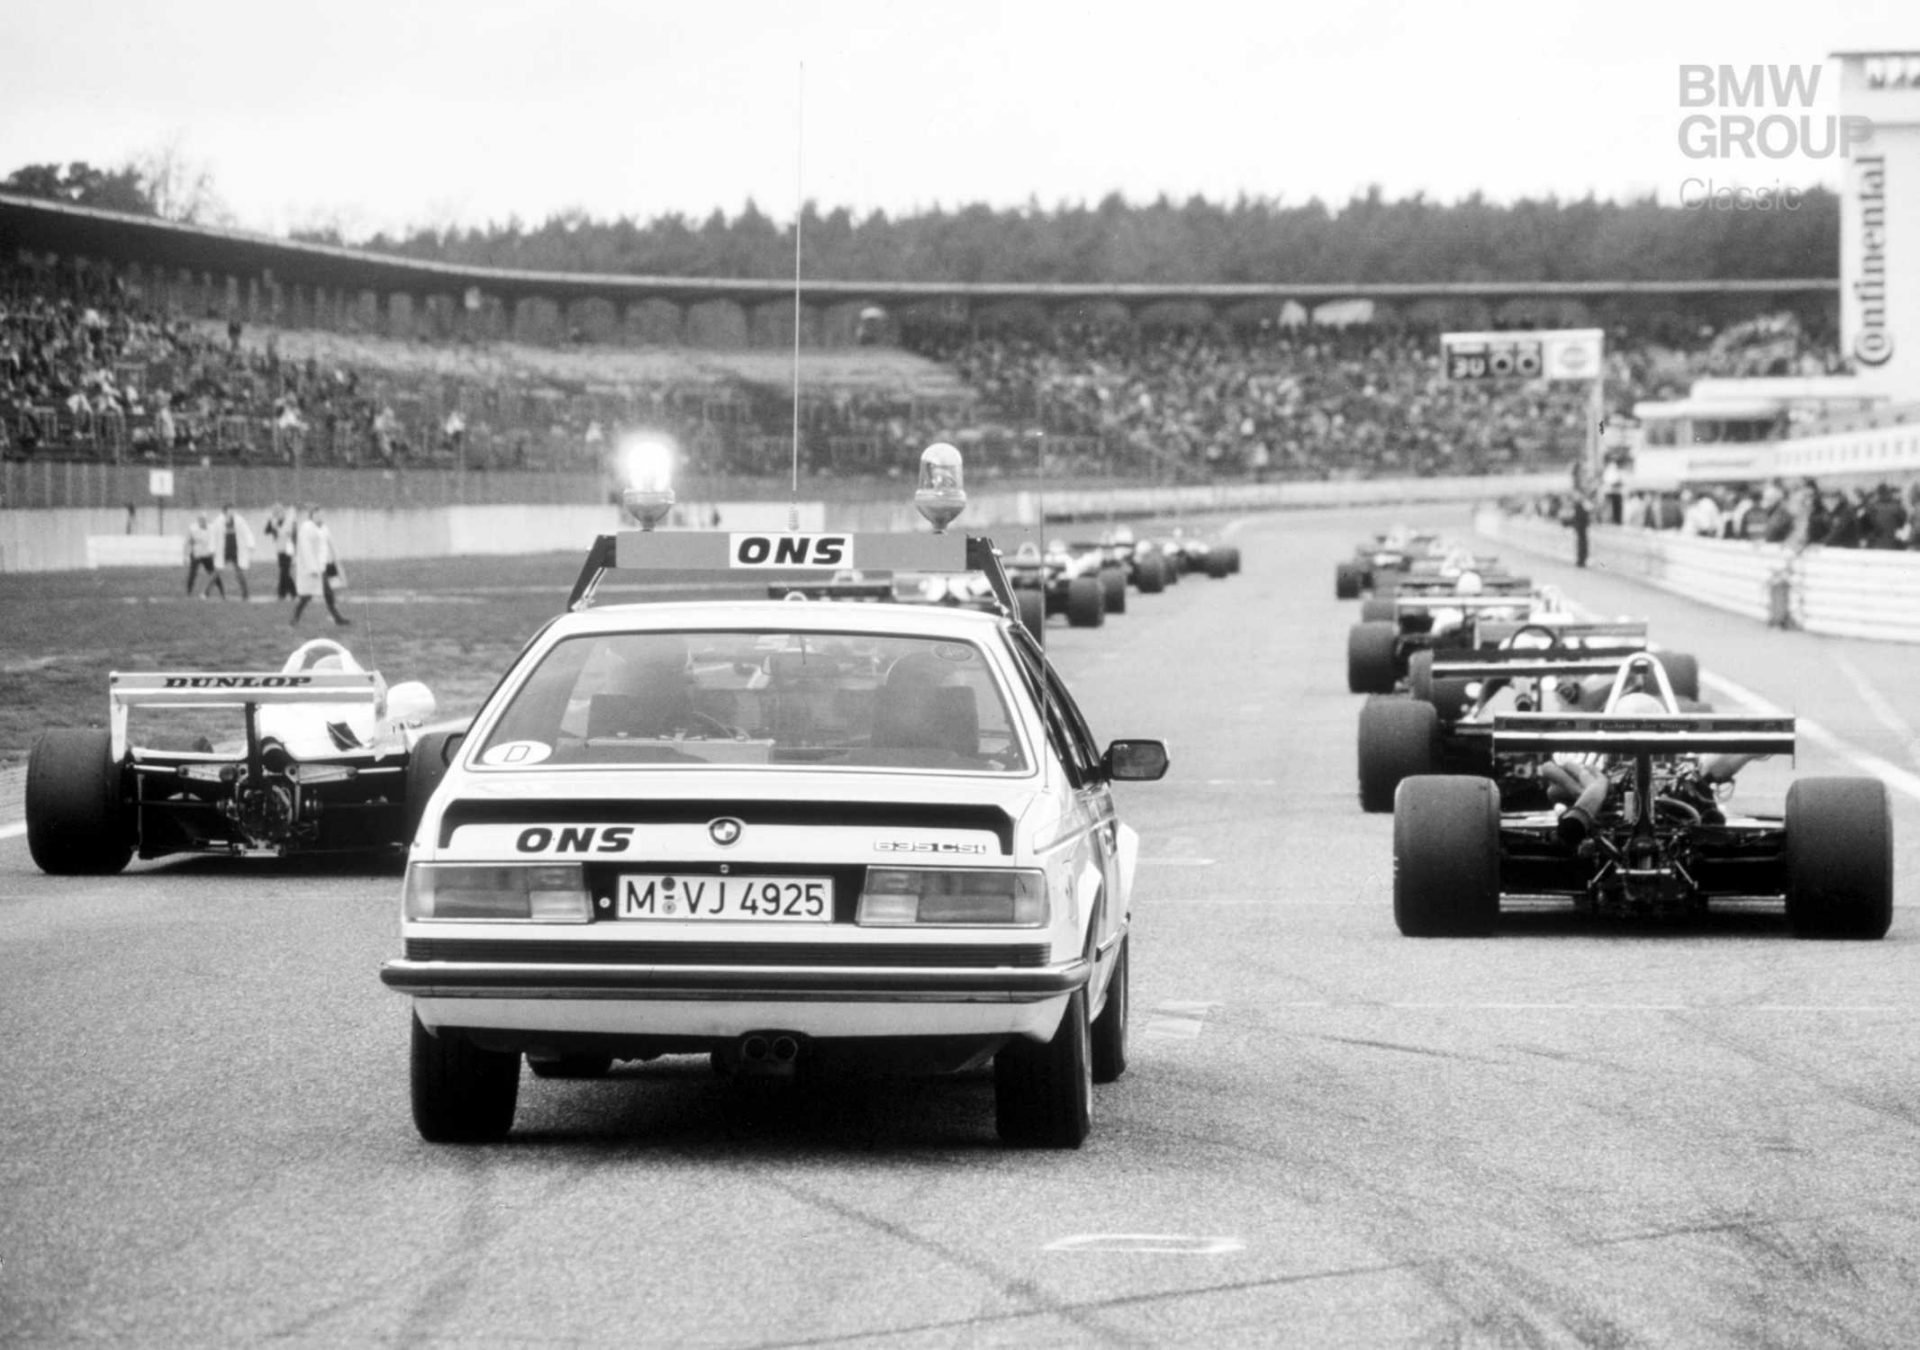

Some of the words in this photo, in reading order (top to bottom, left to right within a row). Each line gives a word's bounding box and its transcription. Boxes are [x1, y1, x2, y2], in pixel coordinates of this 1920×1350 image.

[1854, 156, 1894, 367] Continental
[737, 537, 846, 565] ONS
[164, 676, 312, 689] DUNLOP
[503, 744, 531, 763] D
[515, 827, 635, 853] ONS
[740, 882, 824, 916] 4925
